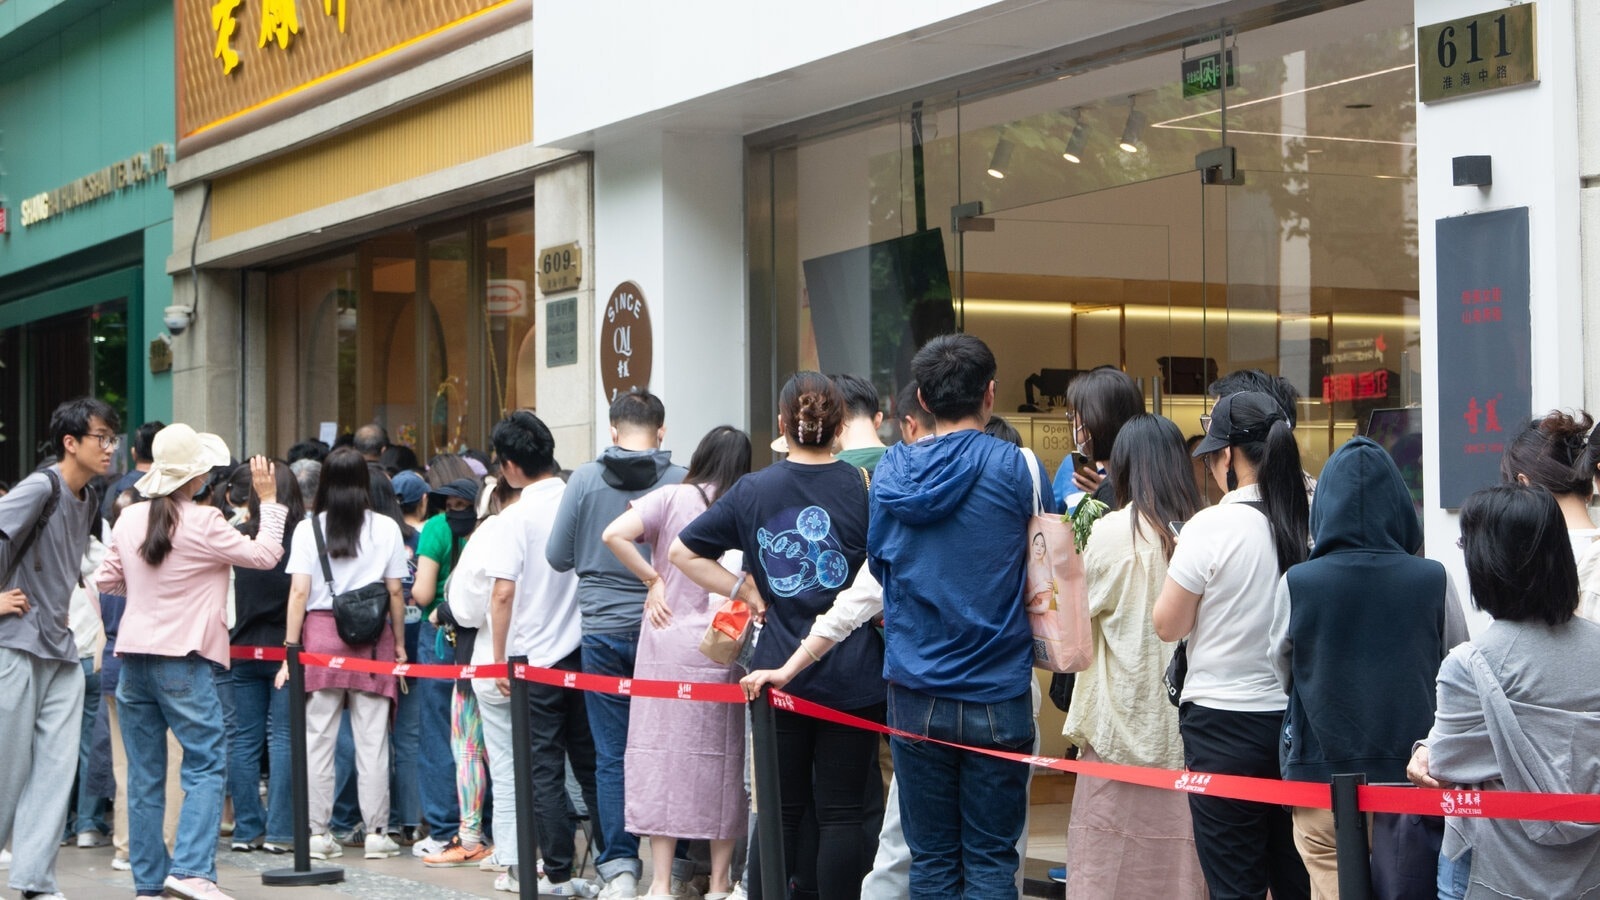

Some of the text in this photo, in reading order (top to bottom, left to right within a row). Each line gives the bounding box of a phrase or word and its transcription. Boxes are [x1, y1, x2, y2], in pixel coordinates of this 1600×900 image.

[1437, 14, 1511, 68] 611
[1442, 65, 1507, 90] 淮海中路
[543, 250, 571, 274] 609
[607, 293, 642, 323] SINCE
[1042, 436, 1070, 450] 09:3
